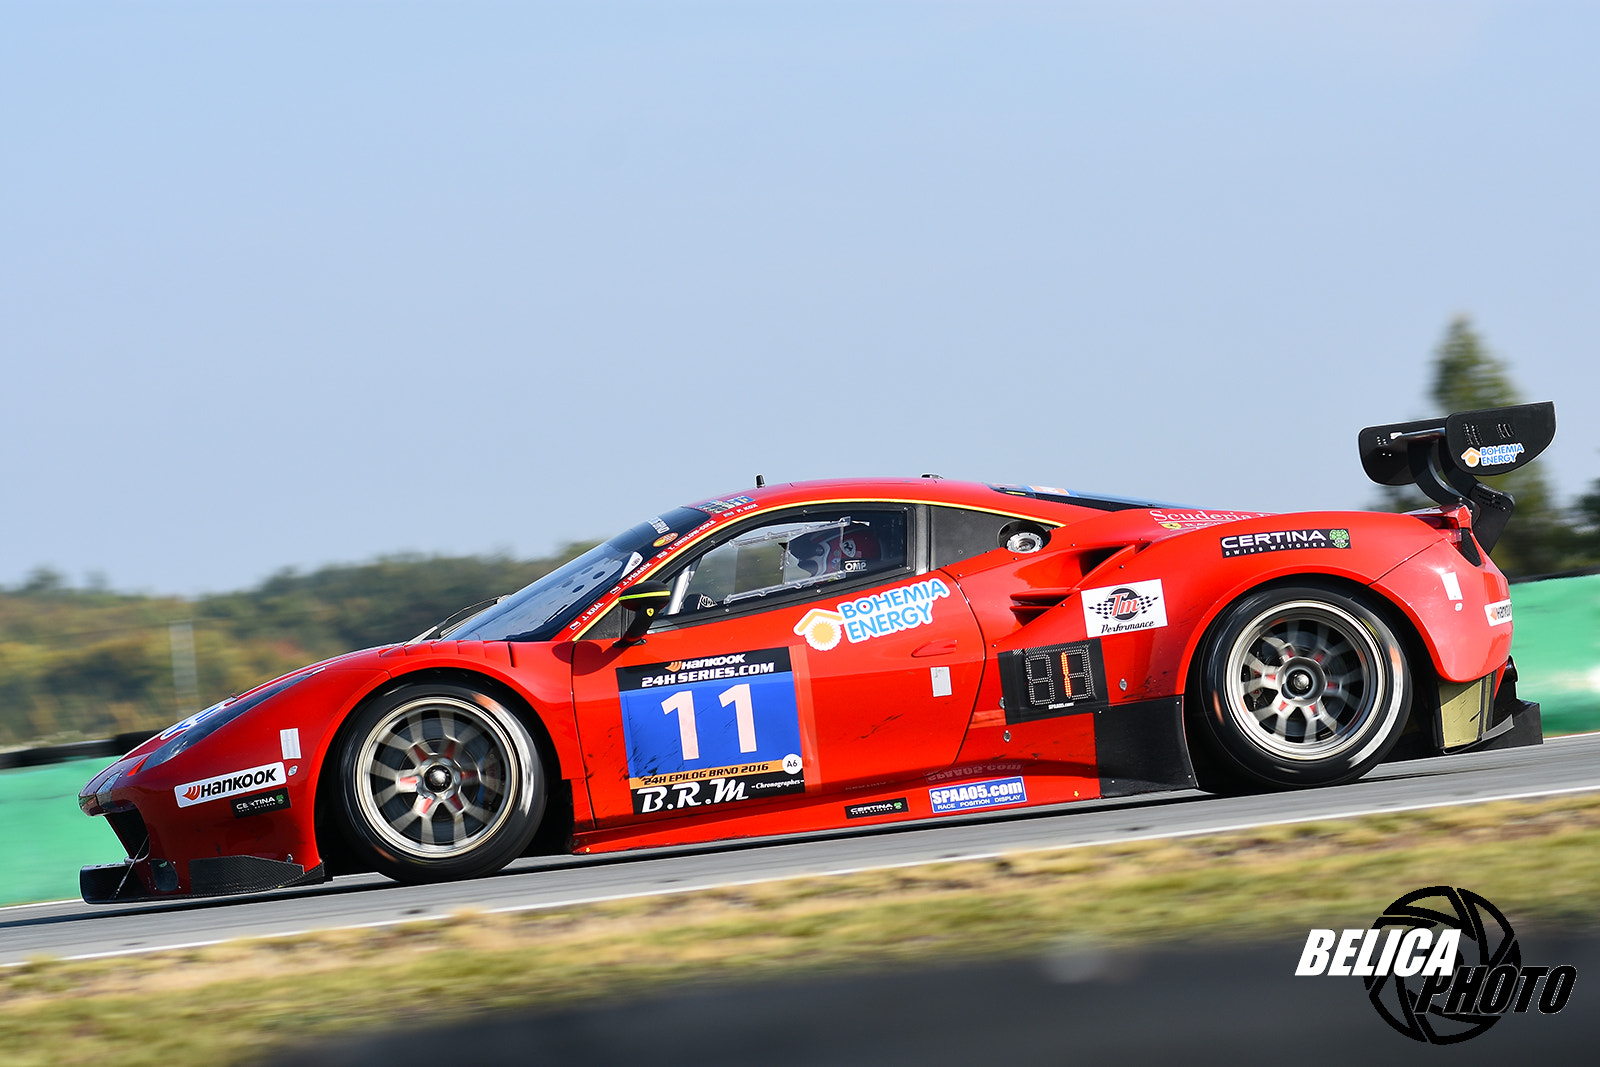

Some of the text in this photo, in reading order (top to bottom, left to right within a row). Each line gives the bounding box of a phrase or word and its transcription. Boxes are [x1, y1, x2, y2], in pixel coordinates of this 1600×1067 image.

[1481, 444, 1524, 456] BOHEMIA
[1482, 453, 1516, 465] ENERGY
[1149, 510, 1252, 522] Scuderia
[1221, 530, 1327, 549] CERTINA
[1225, 542, 1325, 556] SWISS WATCHES
[845, 562, 867, 570] OMP
[840, 580, 947, 619] BOHEMIA
[847, 602, 930, 640] ENERGY
[1101, 620, 1154, 634] Performance
[641, 662, 775, 688] 24H SERIES.COM
[660, 683, 757, 760] 11
[786, 759, 798, 768] A6
[643, 763, 769, 785] 24H EPILOG BRNO 2016
[850, 803, 894, 813] CERTINA
[937, 794, 1021, 811] RACE POSITION DISPLAY
